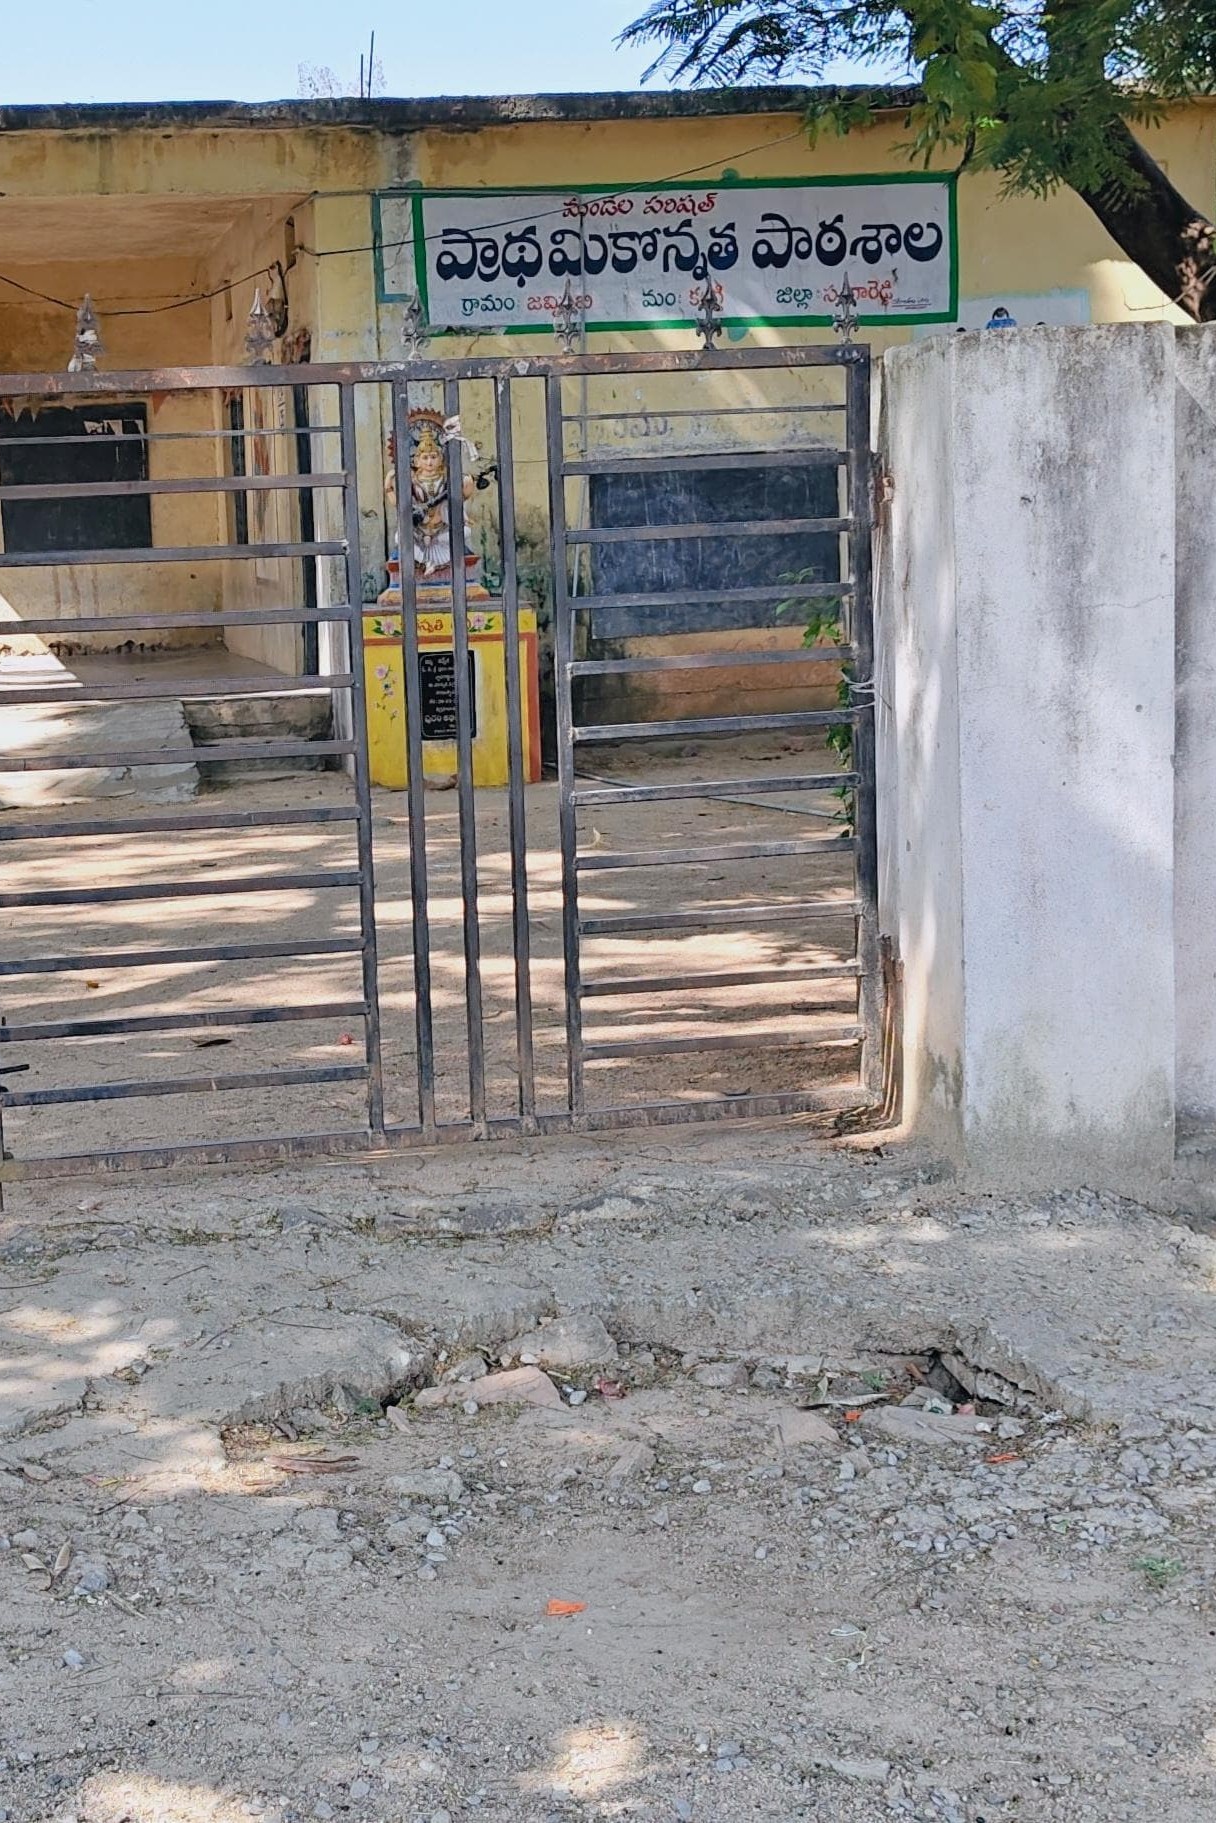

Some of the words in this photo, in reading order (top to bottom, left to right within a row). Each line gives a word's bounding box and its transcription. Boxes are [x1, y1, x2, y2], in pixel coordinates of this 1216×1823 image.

[562, 196, 634, 218] మండల
[643, 192, 718, 216] పరిషత్
[751, 212, 943, 269] పాఠశాల
